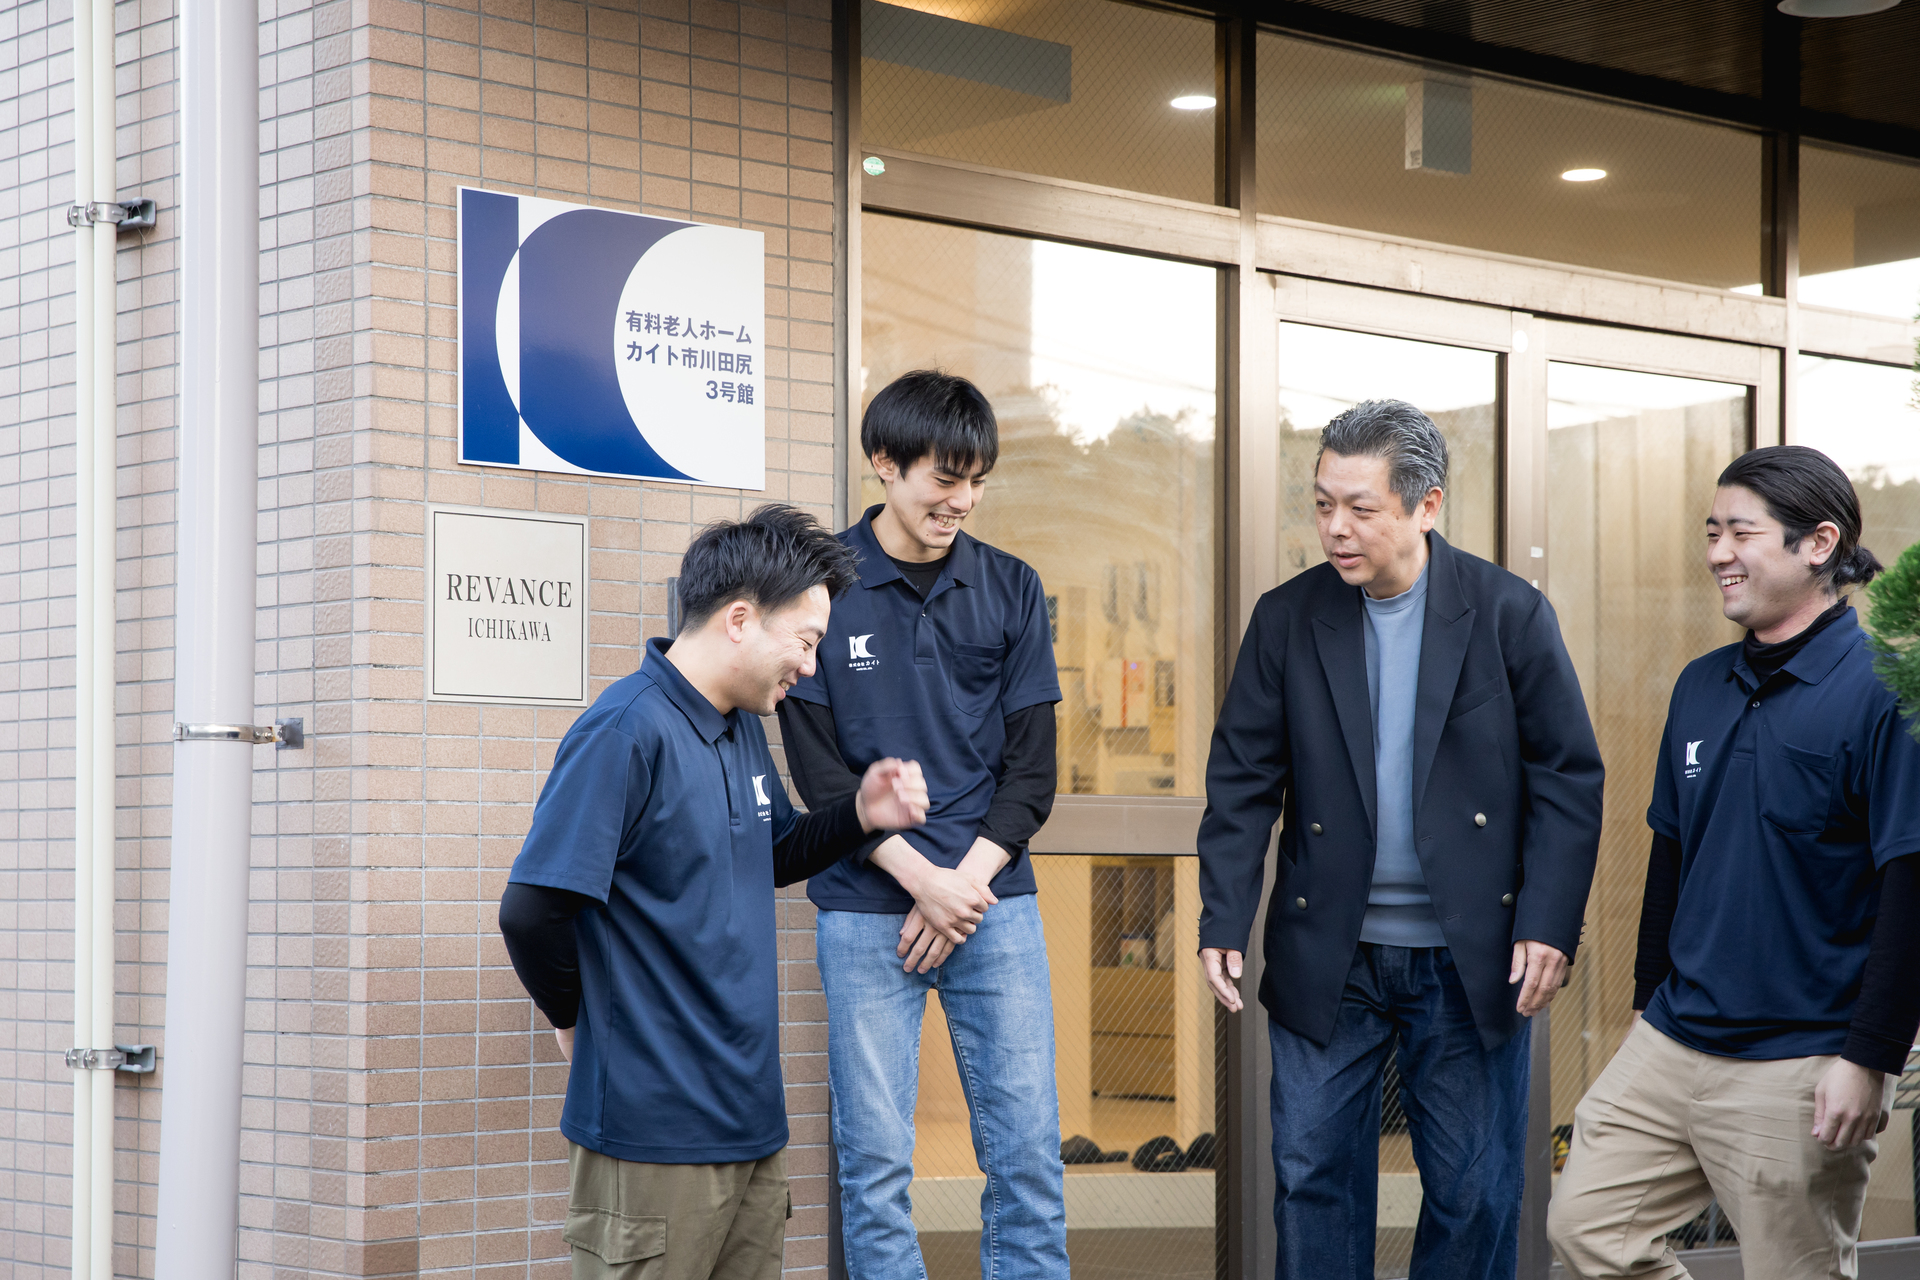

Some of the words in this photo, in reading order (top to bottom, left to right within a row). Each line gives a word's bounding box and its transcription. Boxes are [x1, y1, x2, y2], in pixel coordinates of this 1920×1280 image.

[625, 310, 752, 344] 有料老人ホーム
[626, 341, 753, 375] カイト市川田尻
[706, 380, 754, 405] 3号館
[446, 573, 572, 608] REVANCE
[468, 617, 551, 642] ICHIKAWA
